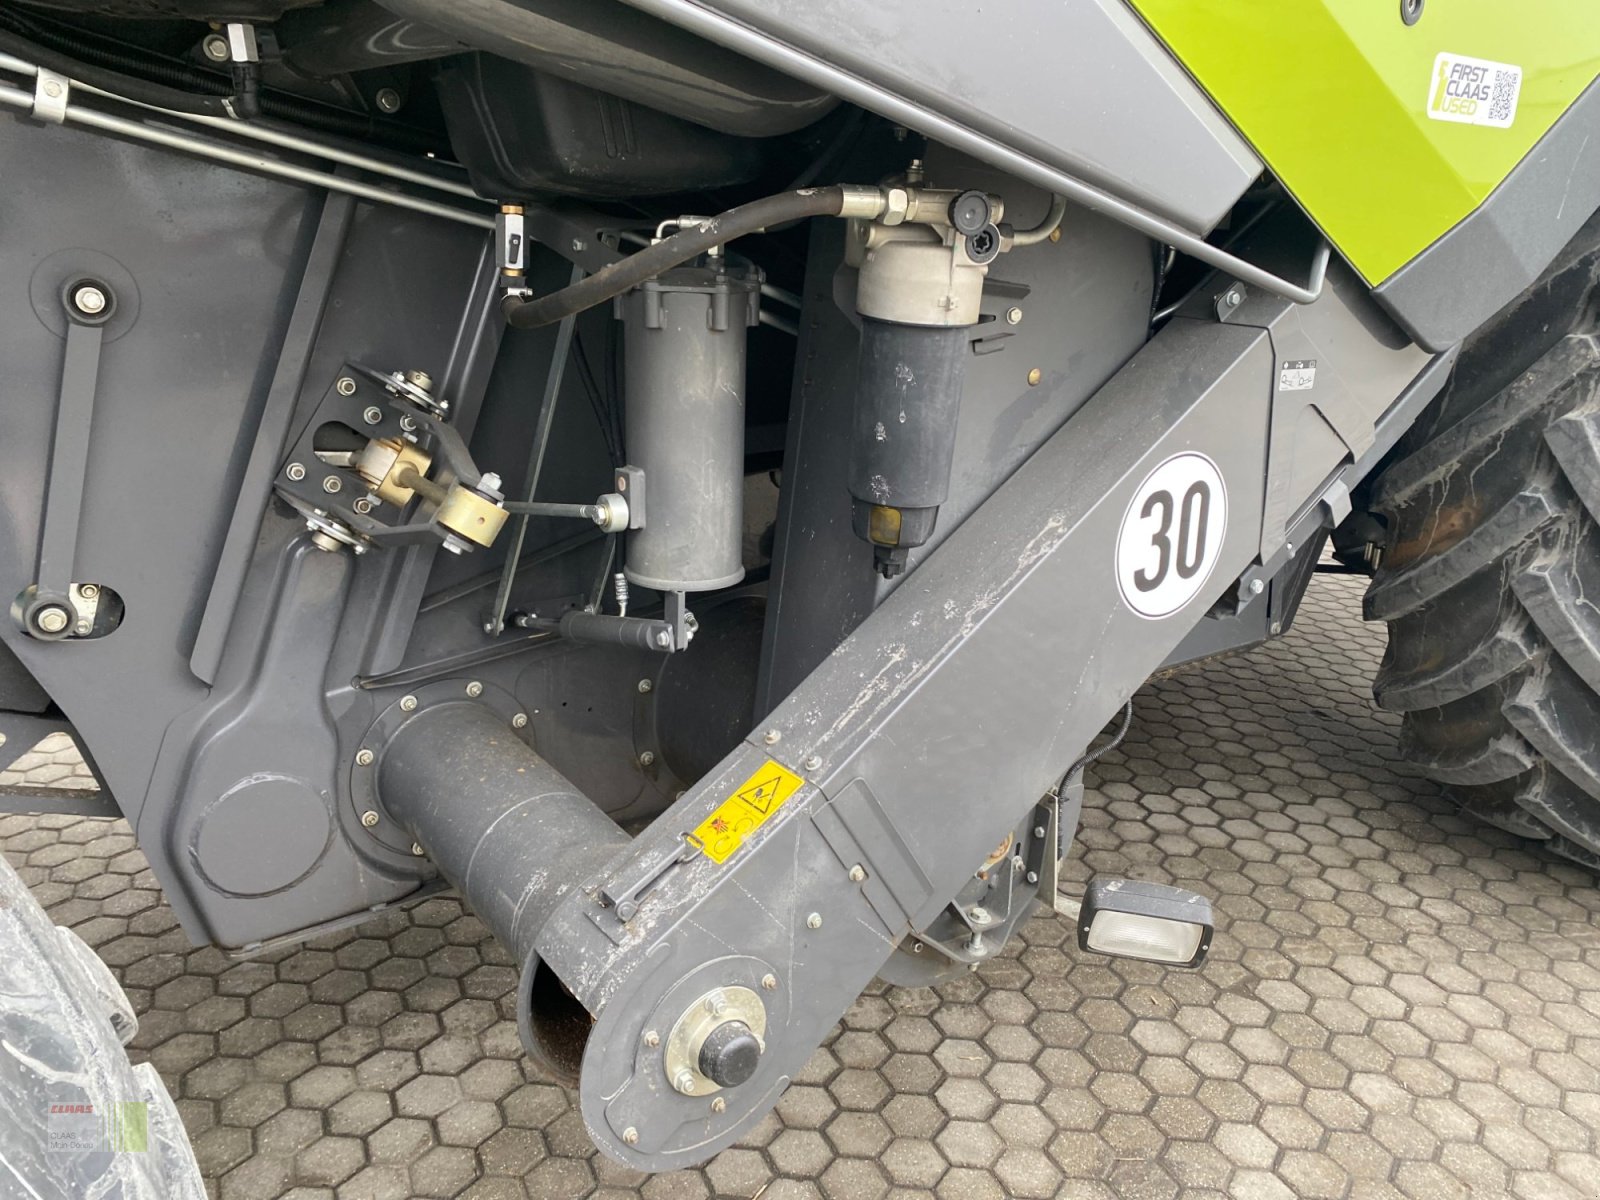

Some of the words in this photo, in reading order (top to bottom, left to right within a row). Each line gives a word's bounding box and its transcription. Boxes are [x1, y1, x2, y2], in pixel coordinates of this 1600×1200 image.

[1450, 63, 1488, 83] FIRST
[1446, 80, 1490, 101] CLAAS
[1442, 97, 1477, 115] USED
[1134, 480, 1210, 592] 30
